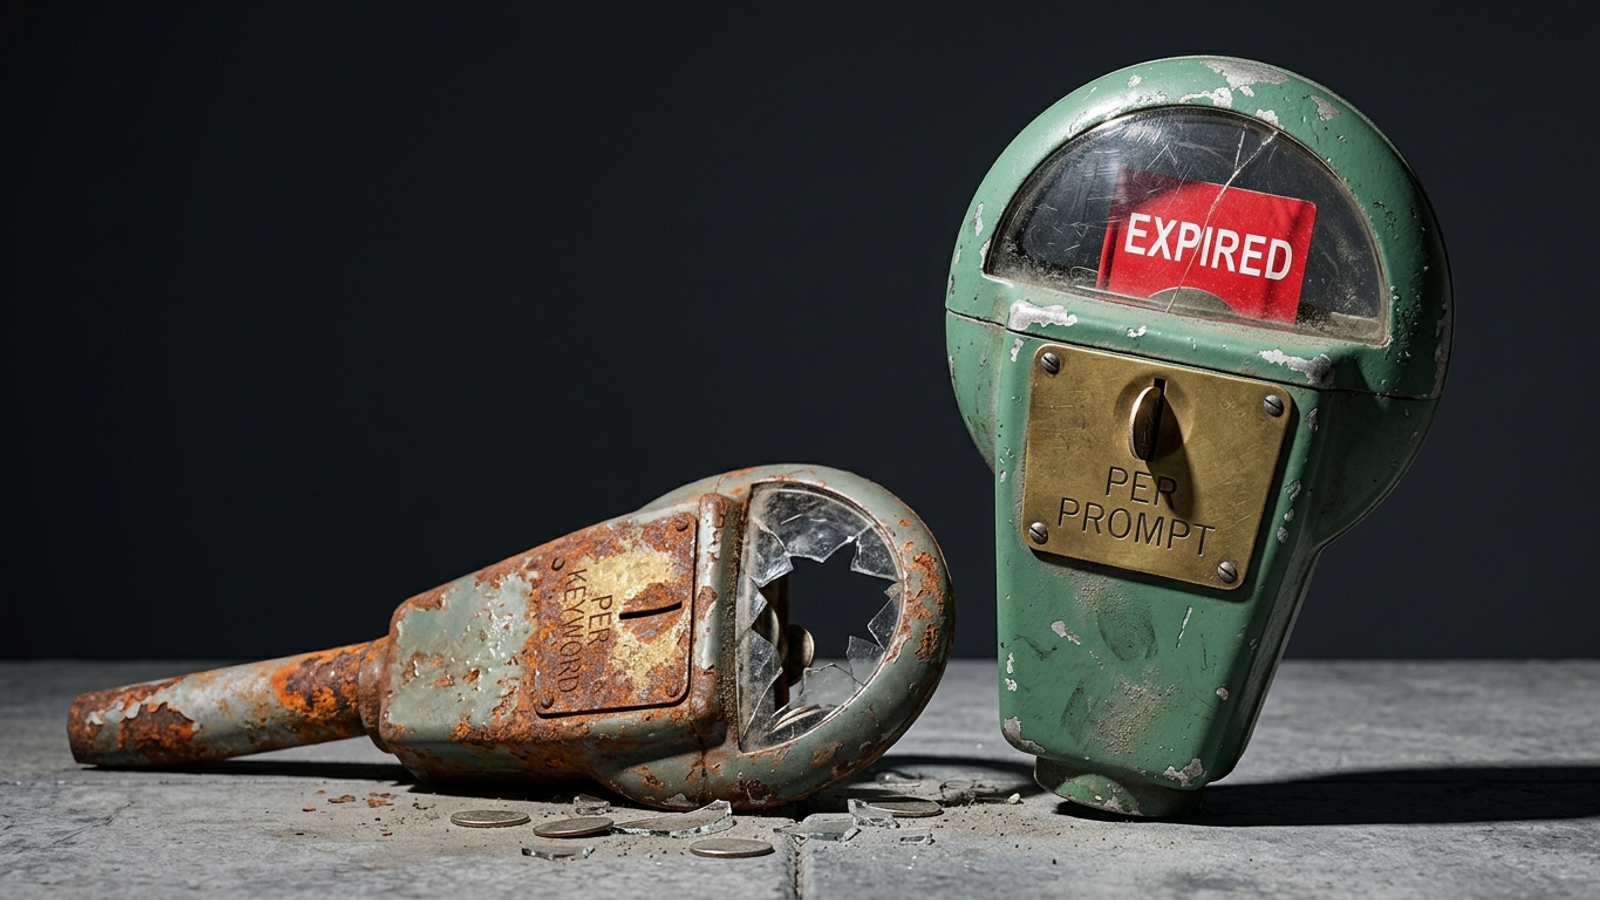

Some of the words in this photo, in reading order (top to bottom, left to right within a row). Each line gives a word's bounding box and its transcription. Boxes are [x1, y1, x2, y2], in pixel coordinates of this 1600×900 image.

[1124, 212, 1293, 281] EXPIRED
[1105, 466, 1178, 511] PER
[1058, 497, 1216, 557] PROMPT
[558, 568, 587, 693] KEYWORD
[587, 595, 613, 646] PER
